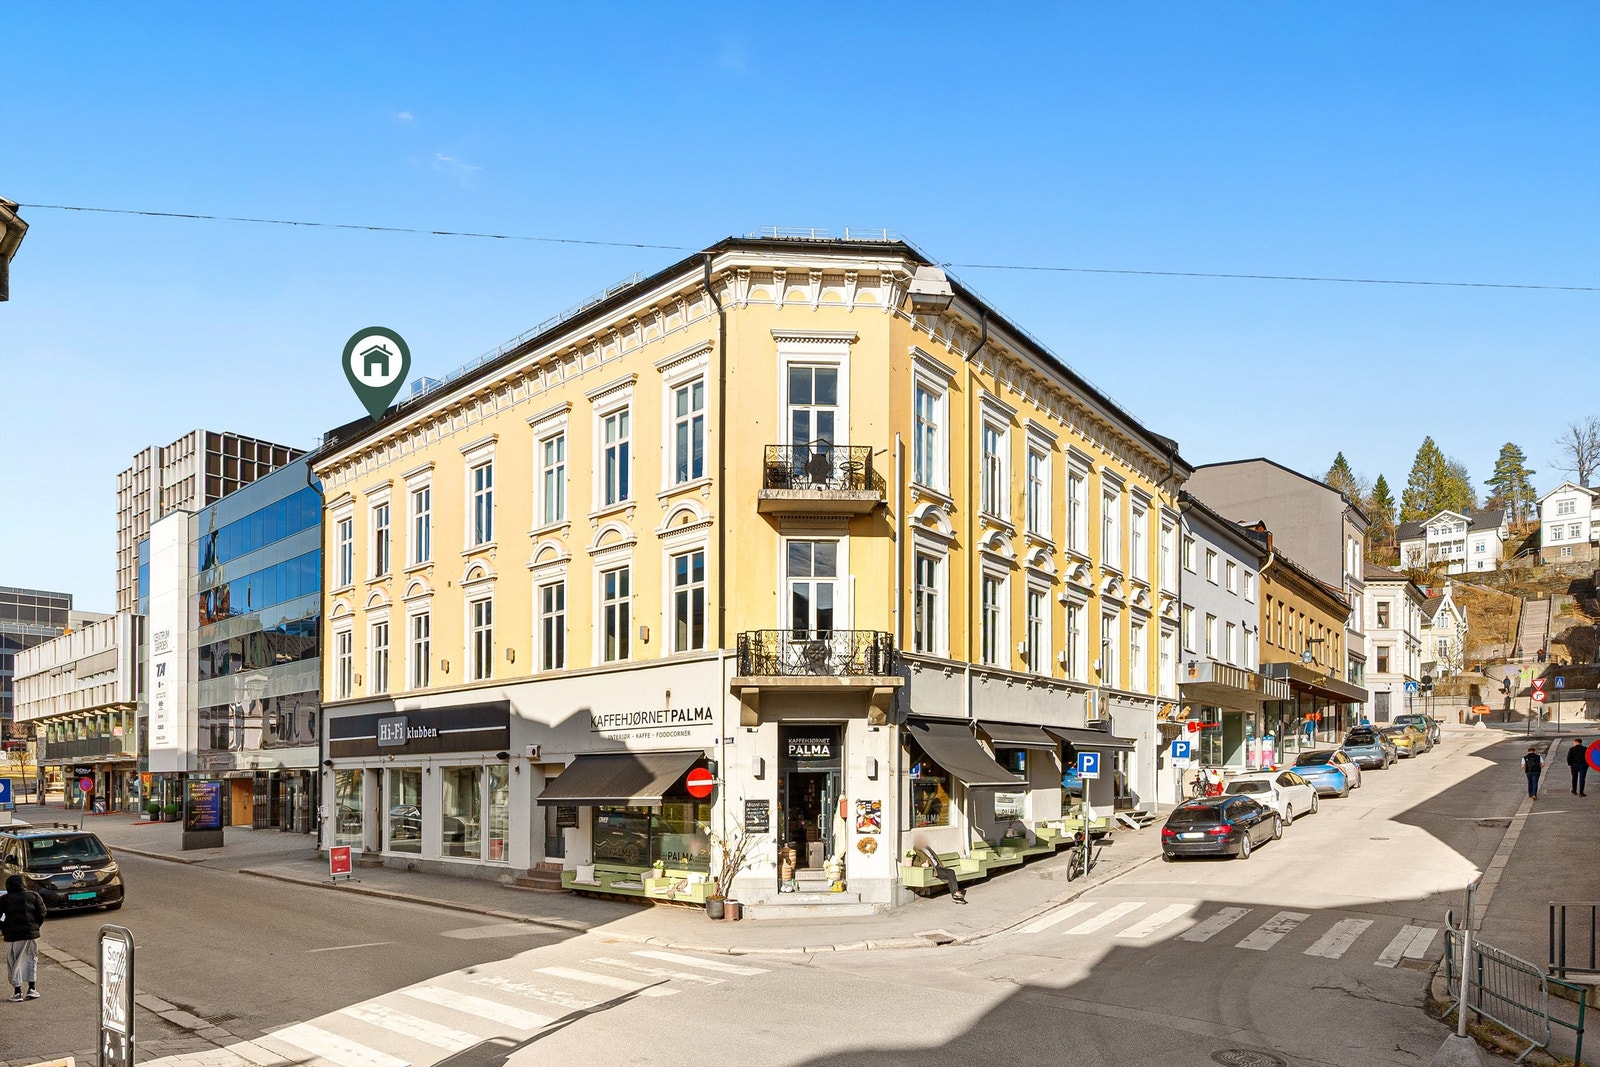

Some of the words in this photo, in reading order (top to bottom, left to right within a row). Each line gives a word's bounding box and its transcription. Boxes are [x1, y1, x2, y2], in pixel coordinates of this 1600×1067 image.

[156, 662, 166, 678] TA
[380, 722, 403, 740] Hi-Fi
[407, 726, 437, 739] klubben
[656, 730, 691, 738] FOODCORNER
[788, 745, 830, 754] PALMA
[1176, 743, 1186, 757] P
[1083, 755, 1095, 772] P
[667, 851, 694, 862] PALMA
